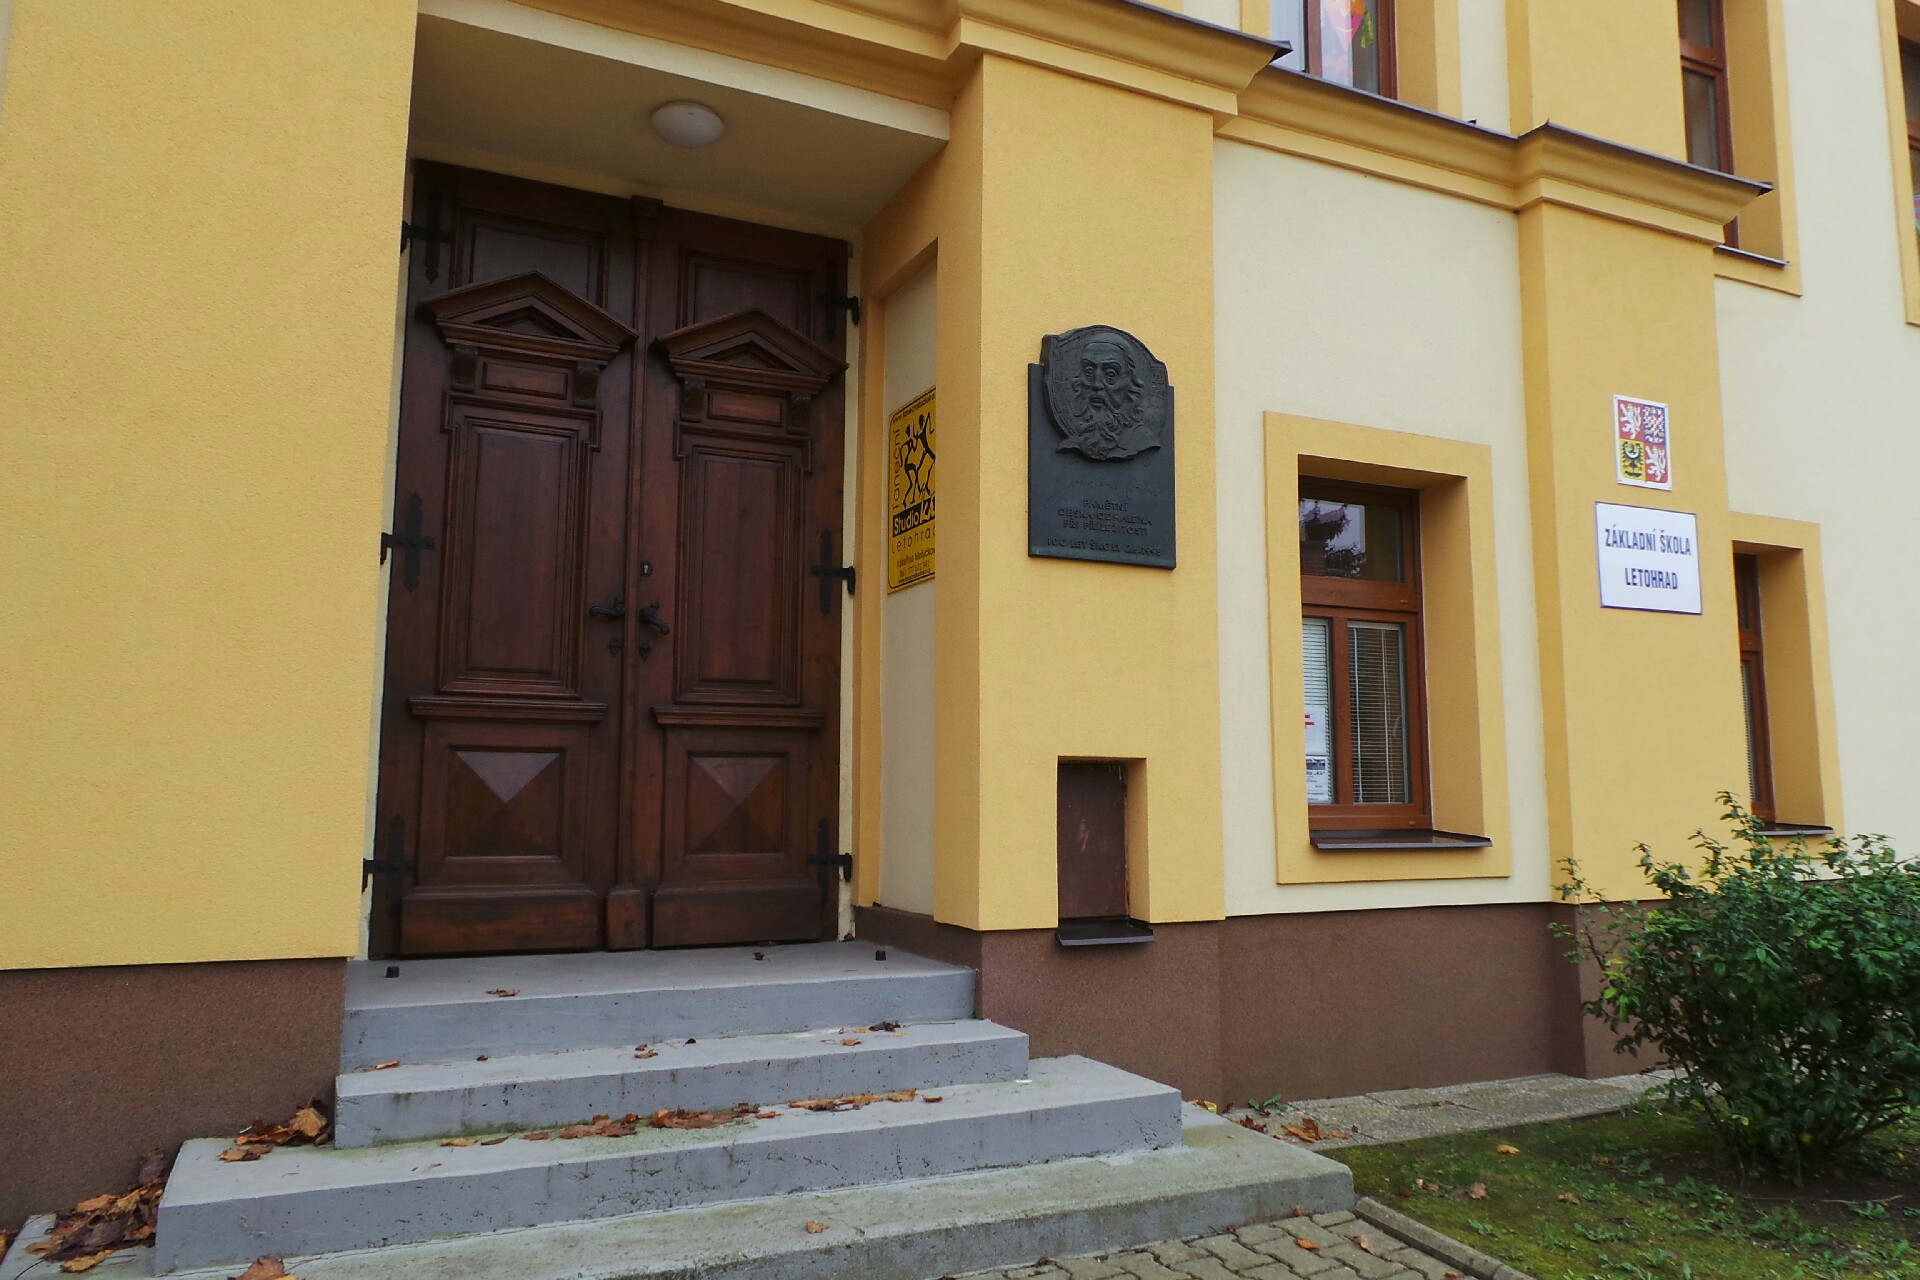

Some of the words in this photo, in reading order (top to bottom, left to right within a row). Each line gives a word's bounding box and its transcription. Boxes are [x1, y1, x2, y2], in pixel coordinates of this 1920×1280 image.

[892, 429, 901, 509] Taneční
[894, 510, 919, 535] Studio
[1059, 508, 1093, 520] DESKA
[1097, 512, 1152, 526] ODHALENA
[1604, 523, 1657, 552] ZÁKLADNÍ
[1660, 529, 1692, 556] ŠKOLA
[1624, 567, 1678, 590] LETOHRAD
